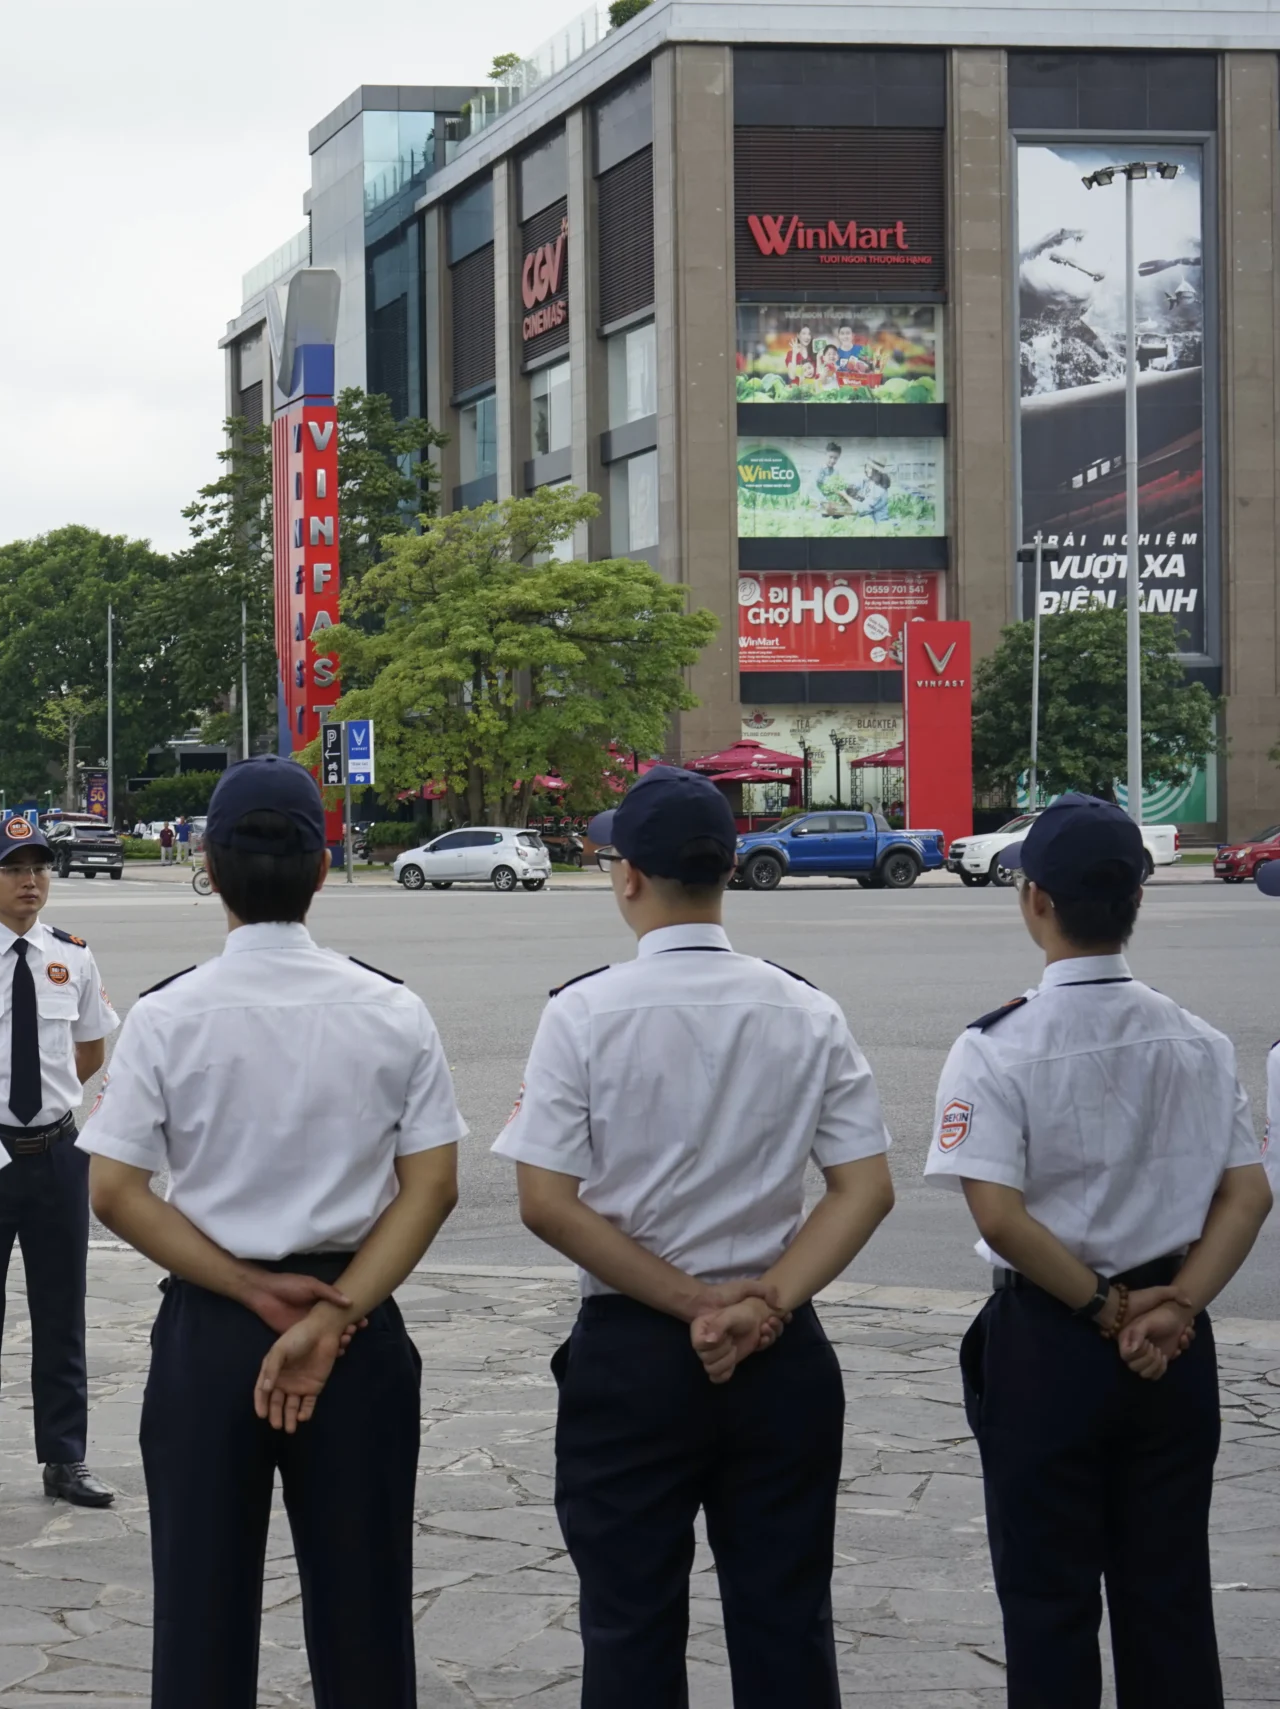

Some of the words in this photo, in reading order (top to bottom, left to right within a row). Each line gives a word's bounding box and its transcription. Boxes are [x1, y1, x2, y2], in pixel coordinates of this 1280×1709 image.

[747, 214, 909, 255] WinMart
[841, 255, 867, 264] NGON
[522, 235, 566, 308] CGV
[523, 301, 566, 340] CINEMAS
[737, 465, 795, 482] WinEco
[1140, 553, 1186, 578] XA
[768, 586, 788, 603] ĐI
[865, 585, 889, 593] 0559
[891, 585, 907, 593] 701
[909, 585, 925, 593] 541
[791, 578, 858, 632] HỘ
[747, 607, 790, 628] CHỢ
[738, 636, 780, 648] WinMart
[917, 680, 965, 688] VINFAST
[796, 719, 810, 729] TEA
[857, 719, 897, 729] BLACKTEA
[327, 729, 337, 748] P
[90, 786, 106, 802] 50
[943, 1112, 969, 1123] SEKIN
